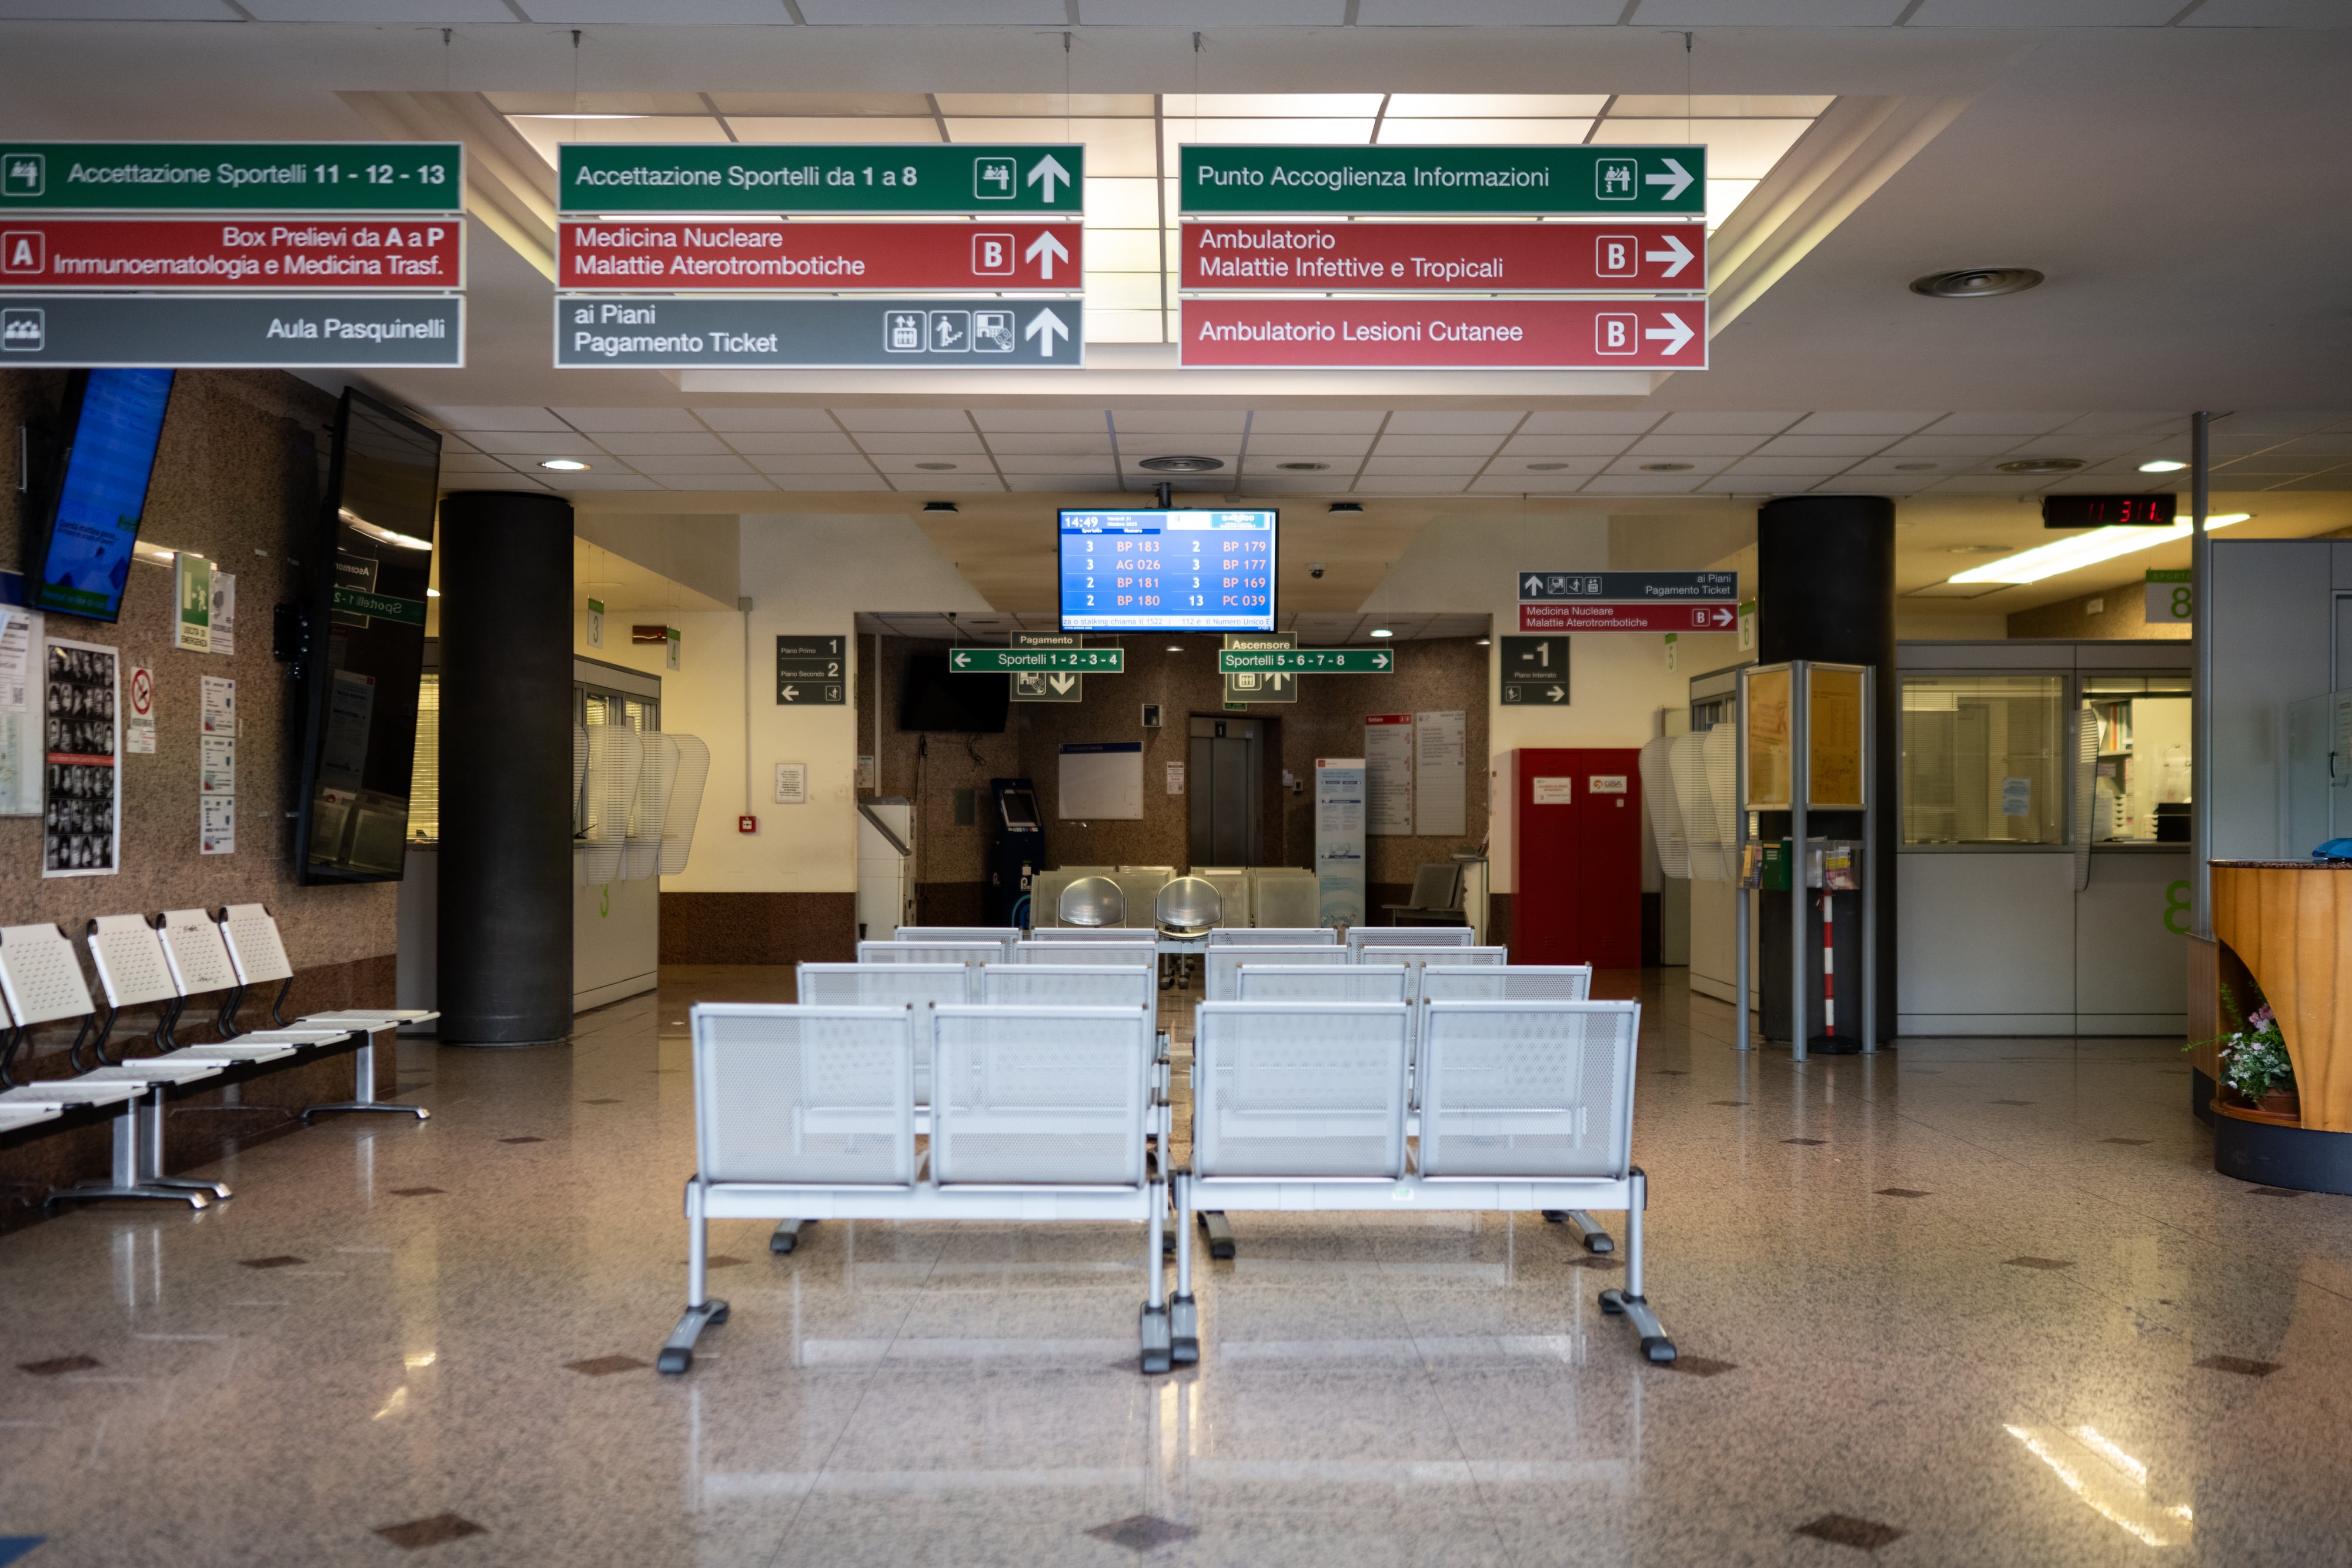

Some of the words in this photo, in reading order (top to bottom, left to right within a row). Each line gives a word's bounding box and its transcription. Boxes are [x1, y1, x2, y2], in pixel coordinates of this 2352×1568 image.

[68, 163, 211, 183] Accettazione
[218, 163, 306, 187] Sportelli
[315, 165, 337, 183] 11
[366, 165, 393, 183] 12
[417, 165, 445, 184] 13
[576, 166, 721, 185] Accettazione
[729, 166, 818, 190] Sportelli
[827, 167, 855, 185] da
[863, 167, 872, 185] 1
[883, 171, 896, 185] a
[903, 167, 917, 186] 8
[1200, 166, 1264, 185] Punto
[1271, 166, 1406, 190] Accoglienza
[1415, 167, 1548, 186] Informazioni
[223, 227, 266, 246] Box
[272, 228, 346, 246] Prelievi
[352, 228, 380, 246] da
[385, 228, 403, 246] A
[408, 232, 422, 247] a
[428, 228, 444, 246] P
[576, 228, 677, 247] Medicina
[684, 228, 783, 247] Nucleare
[1200, 229, 1335, 249] Ambulatorio
[12, 240, 33, 265] A
[985, 242, 1002, 267] B
[1609, 244, 1625, 269] B
[55, 255, 260, 279] Immunoematologia
[265, 260, 279, 274] e
[285, 255, 382, 275] Medicina
[386, 255, 443, 275] Trasf.
[576, 255, 664, 275] Malattie
[670, 256, 865, 275] Aterotrombotiche
[1201, 257, 1288, 276] Malattie
[1297, 258, 1384, 277] Infettive
[1391, 263, 1404, 277] e
[1411, 258, 1502, 282] Tropicali
[575, 305, 594, 324] ai
[602, 305, 655, 324] Piani
[267, 319, 318, 338] Aula
[325, 319, 445, 343] Pasquinelli
[1199, 322, 1335, 340] Ambulatorio
[1344, 322, 1421, 340] Lesioni
[1429, 322, 1522, 341] Cutanee
[1608, 322, 1625, 346] B
[575, 332, 703, 356] Pagamento
[709, 333, 777, 352] Ticket
[1065, 516, 1098, 527] 14:49
[1087, 541, 1093, 551] 3
[1117, 541, 1132, 551] BP
[1138, 541, 1159, 551] 183
[1192, 541, 1200, 552] 2
[1224, 541, 1239, 551] BP
[1245, 541, 1265, 551] 179
[1087, 559, 1093, 570] 3
[1117, 560, 1133, 570] AG
[1138, 560, 1160, 570] 026
[1193, 559, 1200, 570] 3
[1224, 560, 1238, 570] BP
[1244, 560, 1266, 569] 177
[1087, 577, 1094, 588] 2
[1118, 577, 1132, 587] BP
[1138, 577, 1158, 587] 181
[1193, 577, 1200, 588] 3
[1223, 577, 1238, 587] BP
[1244, 578, 1265, 588] 169
[1698, 574, 1705, 583] ai
[1709, 574, 1730, 583] Piani
[1646, 586, 1699, 596] Pagamento
[1702, 586, 1730, 594] Ticket
[1087, 595, 1094, 606] 2
[1118, 596, 1132, 606] BP
[1138, 596, 1160, 606] 180
[1190, 595, 1203, 606] 13
[1223, 596, 1238, 606] PC
[1242, 596, 1265, 606] 039
[2171, 587, 2192, 618] 8
[1527, 607, 1569, 615] Medicina
[1572, 607, 1613, 615] Nucleare
[1698, 612, 1705, 623] B
[1527, 618, 1563, 627] Malattie
[1566, 618, 1648, 627] Aterotrombotiche
[593, 616, 598, 643] 3
[1743, 618, 1750, 646] 6
[830, 640, 836, 653] 1
[1021, 636, 1073, 645] Pagamento
[1231, 640, 1291, 651] Ascensore
[671, 643, 676, 666] 4
[999, 654, 1046, 667] Sportelli
[1051, 654, 1055, 664] 1
[1070, 654, 1077, 664] 2
[1090, 654, 1097, 664] 3
[1110, 654, 1117, 664] 4
[1523, 643, 1548, 666] -1
[1669, 647, 1673, 669] 5
[1226, 655, 1273, 668] Sportelli
[1278, 656, 1285, 666] 5
[1297, 655, 1305, 665] 6
[1318, 655, 1324, 665] 7
[1337, 655, 1344, 665] 8
[828, 663, 838, 676] 2
[1219, 726, 1222, 735] 1
